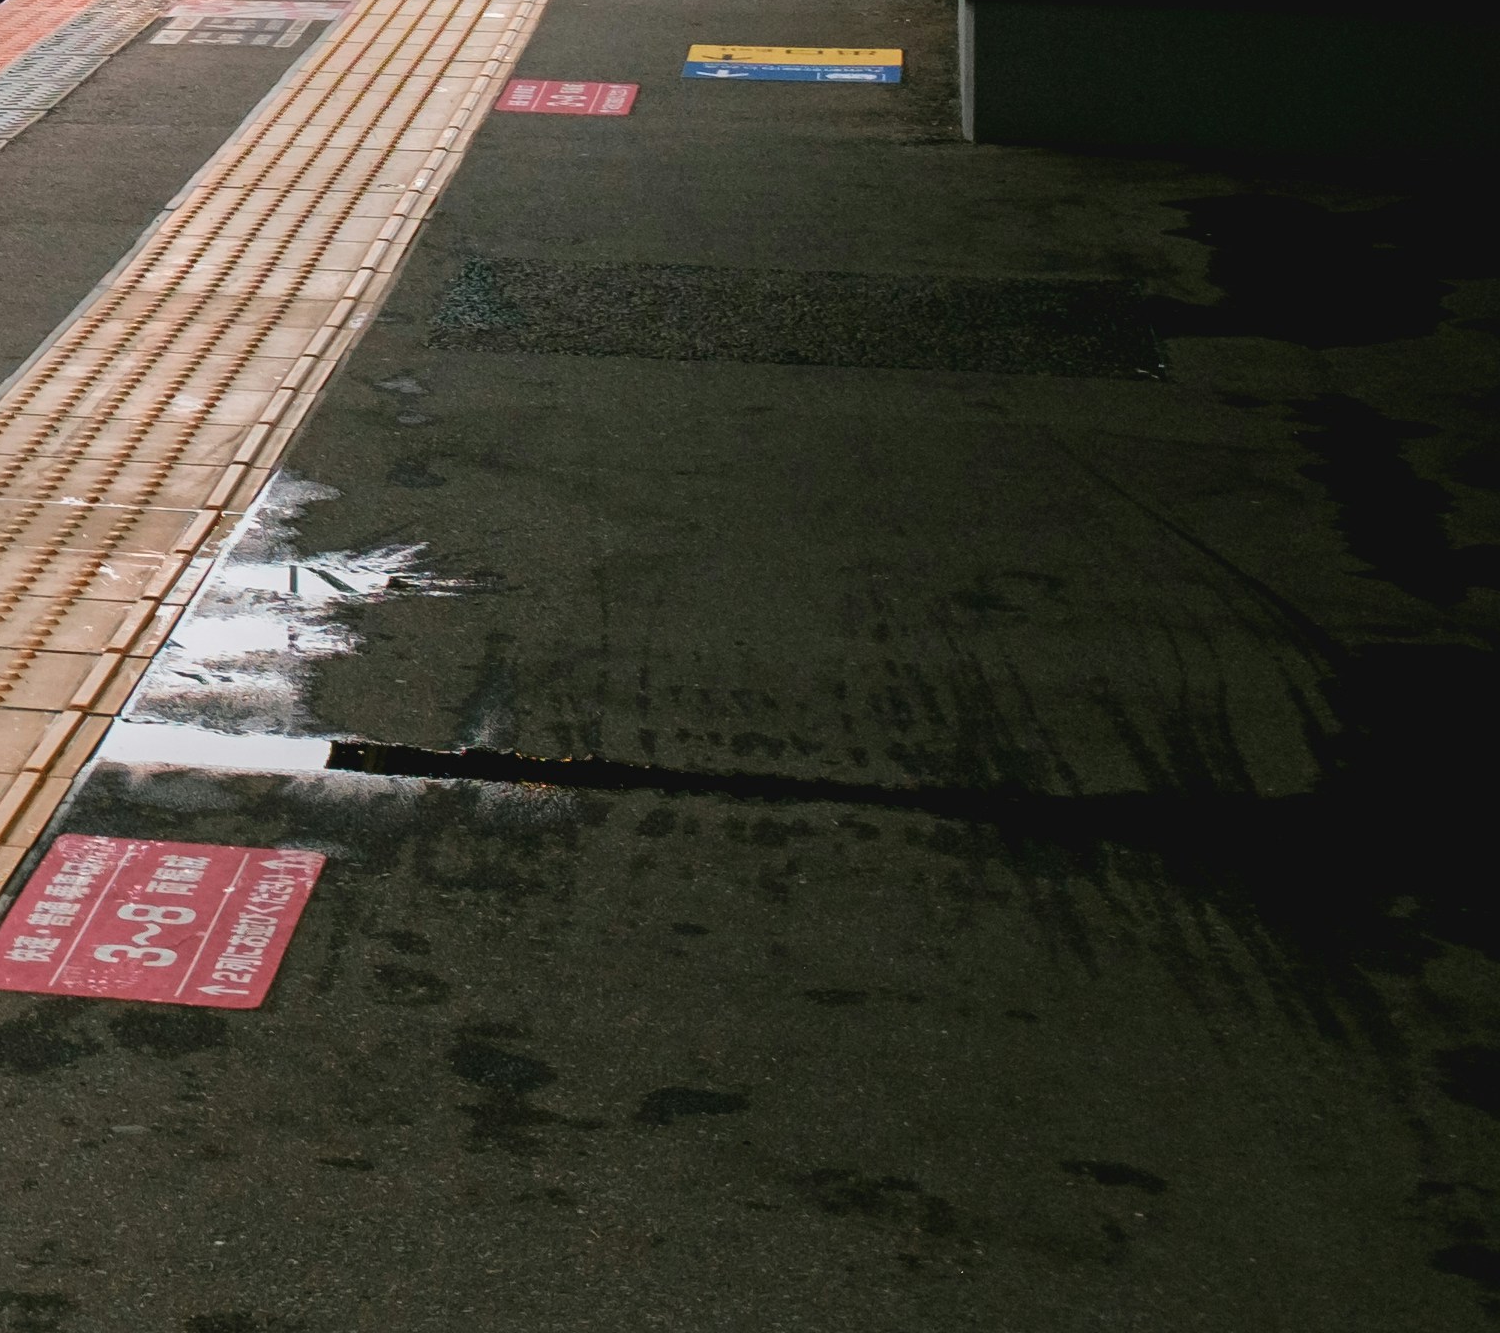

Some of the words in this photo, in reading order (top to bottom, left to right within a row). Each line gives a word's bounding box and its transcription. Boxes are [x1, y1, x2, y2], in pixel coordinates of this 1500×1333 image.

[211, 874, 297, 983] 2列にお並びください
